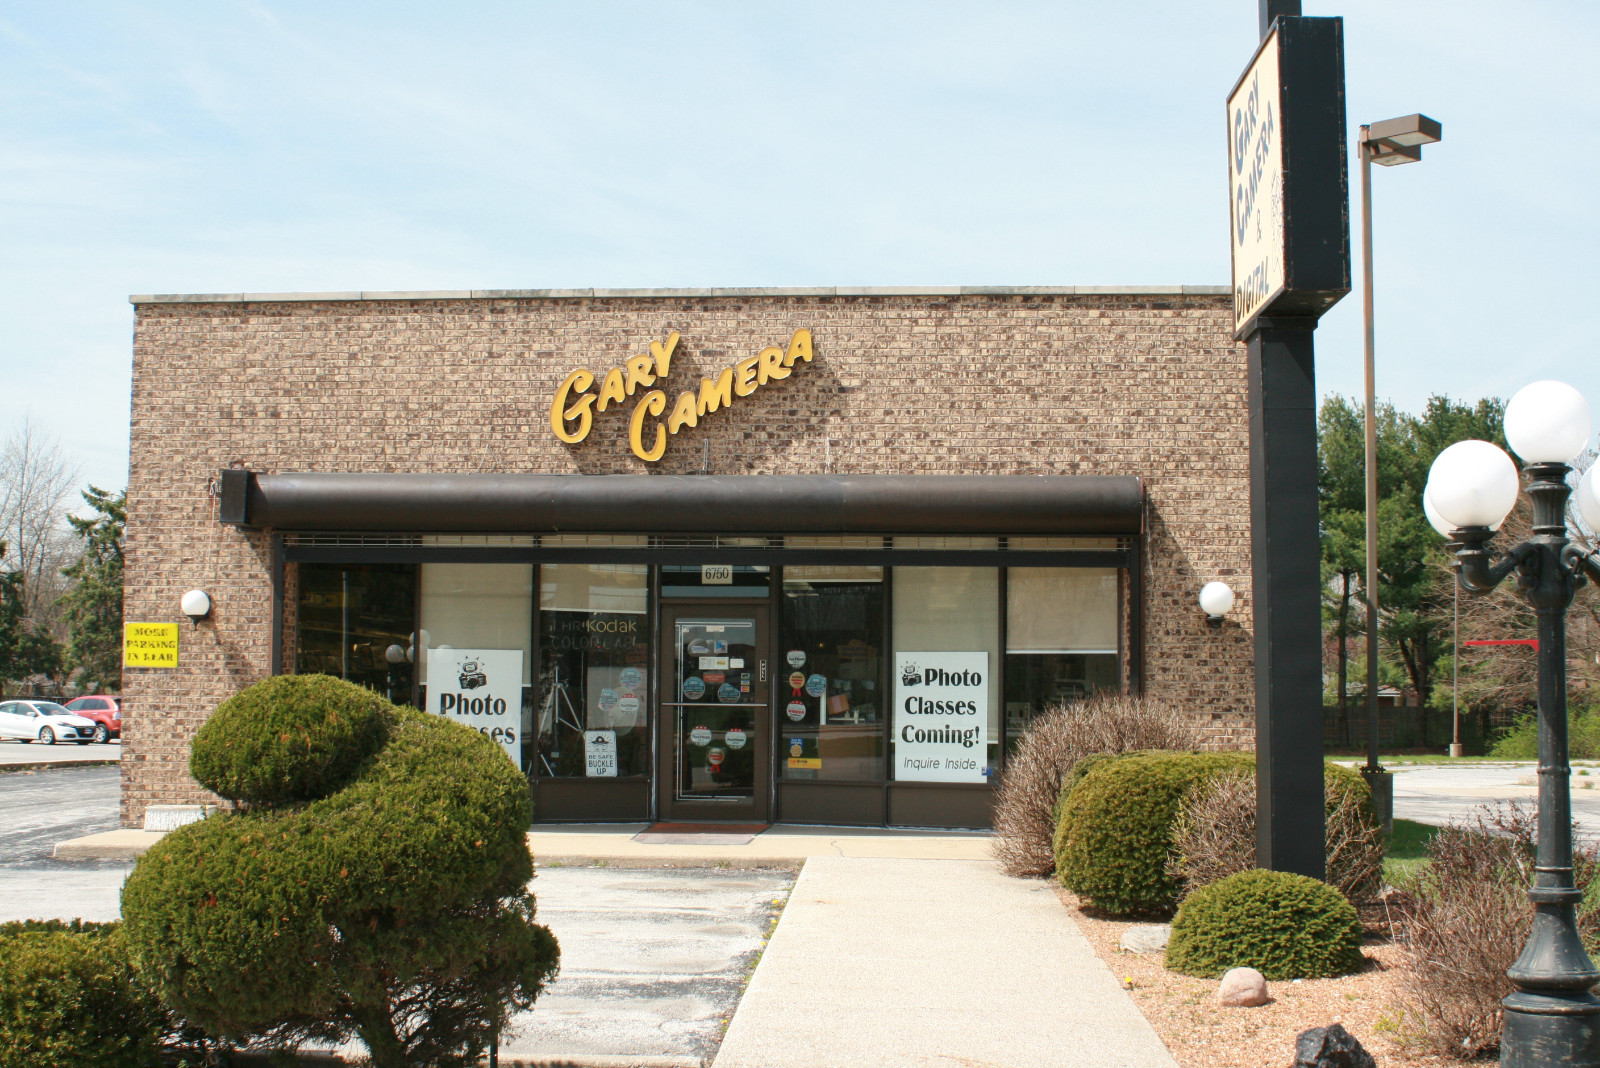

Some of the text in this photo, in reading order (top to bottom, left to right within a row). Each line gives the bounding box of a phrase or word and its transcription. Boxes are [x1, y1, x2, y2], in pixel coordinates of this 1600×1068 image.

[1235, 69, 1259, 176] GARY
[1236, 100, 1274, 247] CAMERA
[1236, 255, 1270, 323] DIGITAL
[550, 331, 680, 443] GARY
[628, 328, 813, 462] CAMERA
[705, 567, 729, 579] 6750
[587, 619, 637, 633] Kodak
[126, 640, 176, 648] PARKING
[924, 668, 982, 687] Photo
[440, 693, 507, 716] Photo
[904, 696, 977, 716] Classes
[901, 724, 980, 749] Coming!
[588, 760, 614, 768] BUCKLE
[596, 768, 607, 776] UP
[904, 757, 940, 771] Inquire
